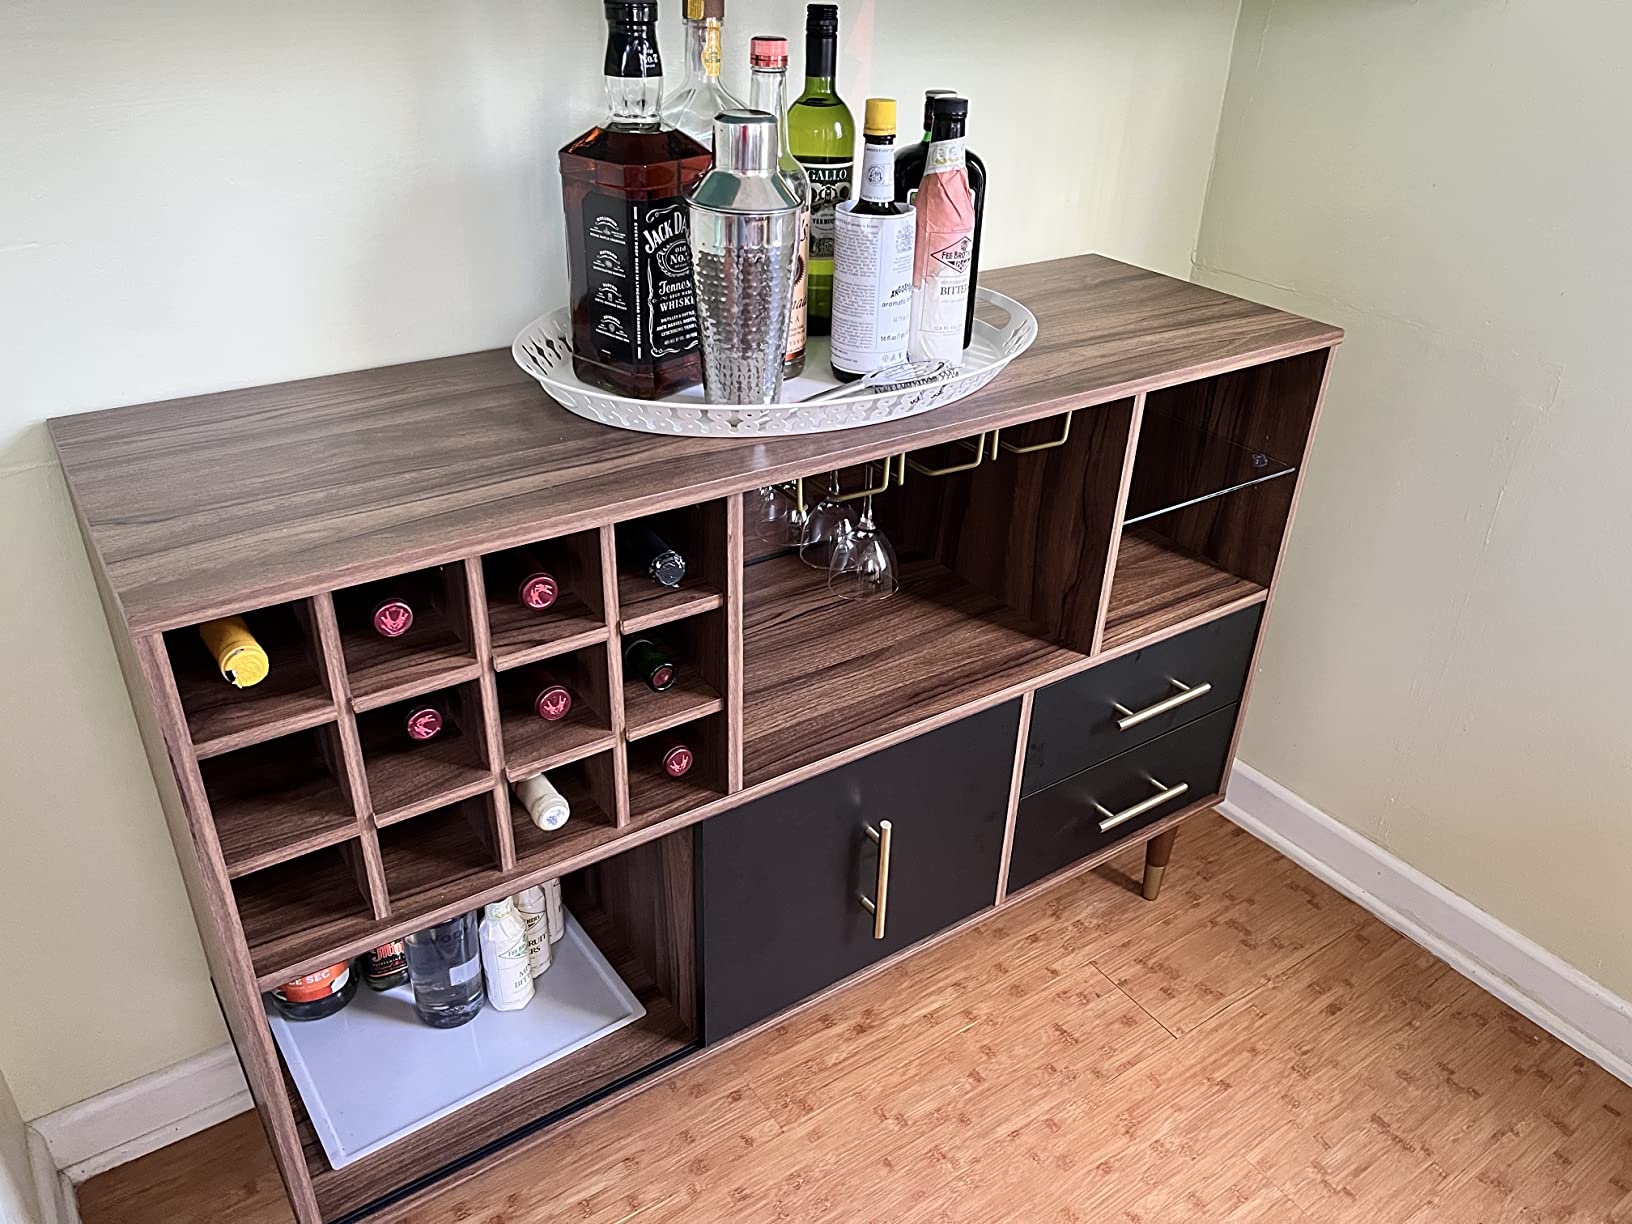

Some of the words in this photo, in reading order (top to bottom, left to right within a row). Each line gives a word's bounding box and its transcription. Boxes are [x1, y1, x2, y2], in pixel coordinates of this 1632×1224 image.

[807, 169, 847, 181] GALLO
[643, 219, 673, 254] JACK
[941, 251, 953, 260] FEE
[305, 968, 331, 985] SEC
